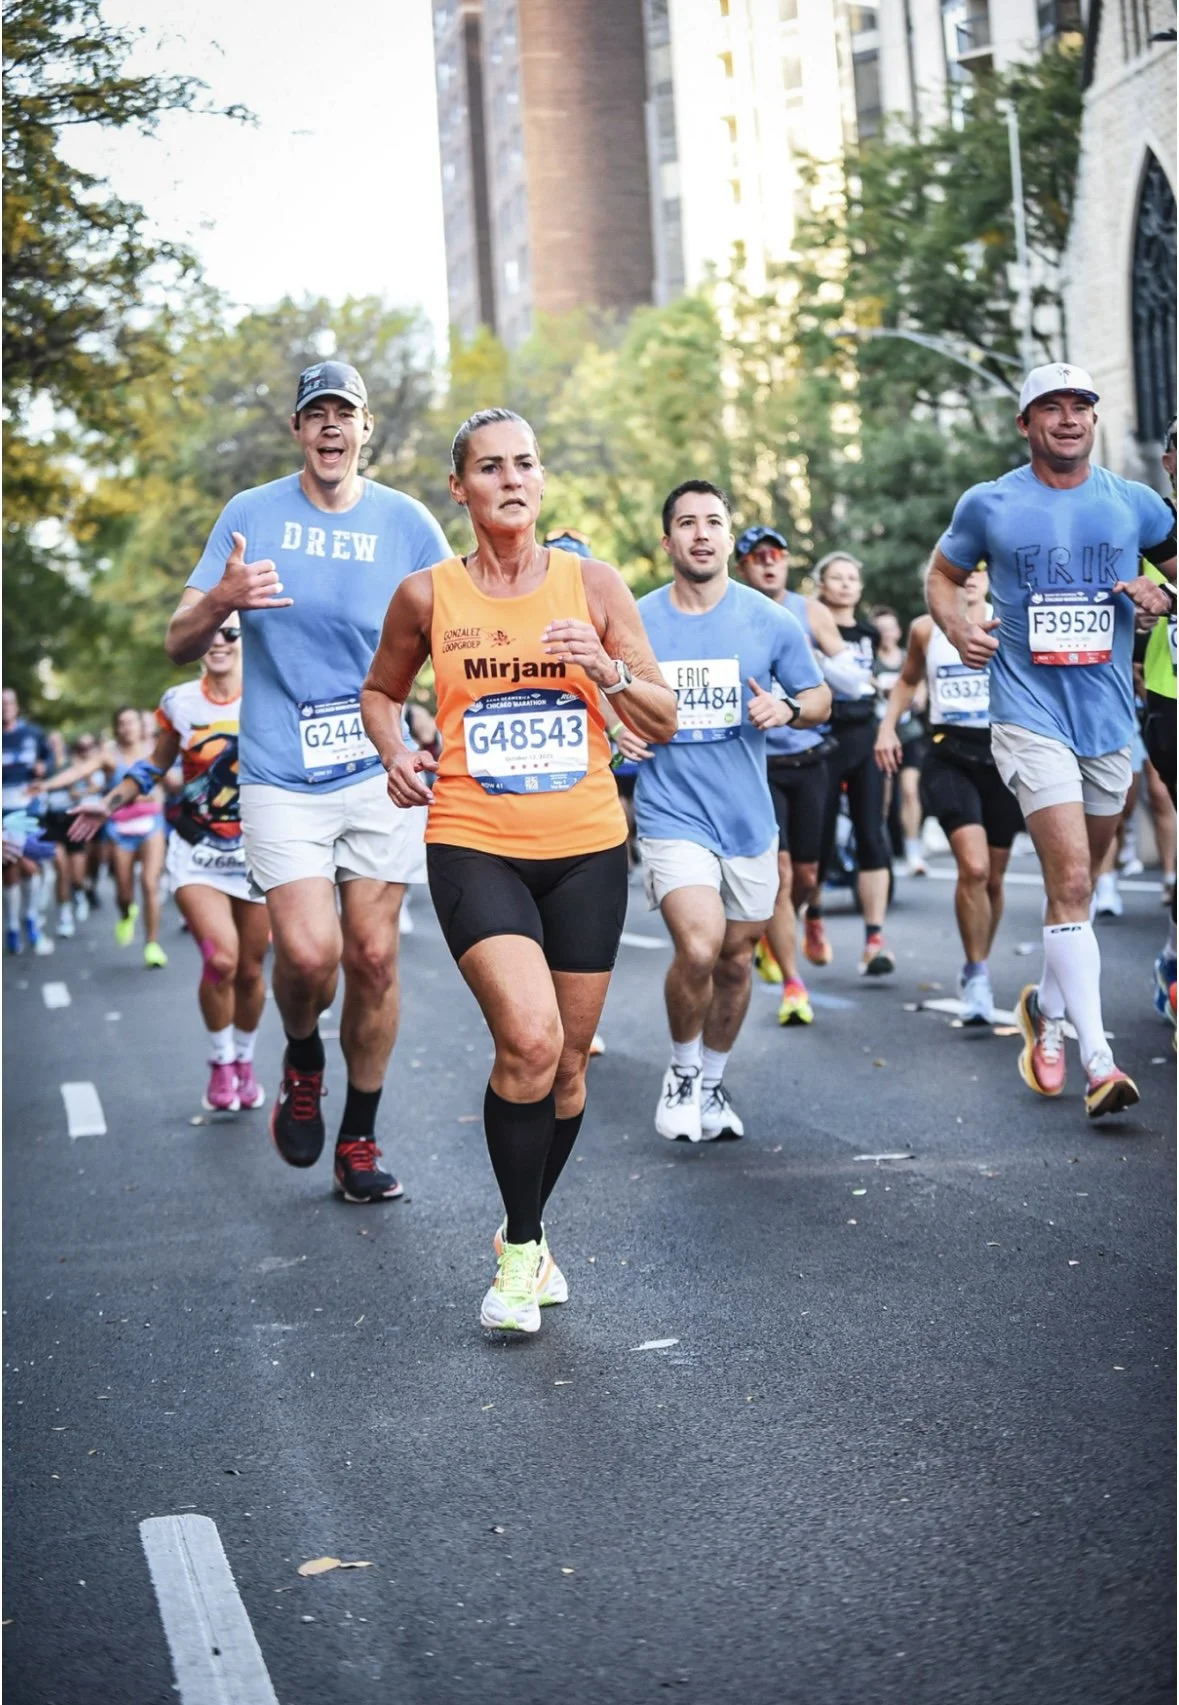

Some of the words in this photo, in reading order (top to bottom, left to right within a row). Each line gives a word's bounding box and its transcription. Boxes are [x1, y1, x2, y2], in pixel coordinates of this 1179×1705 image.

[281, 521, 378, 562] DREW
[1015, 542, 1123, 589] ERIK
[443, 628, 481, 640] GONZALEZ
[1033, 610, 1111, 634] F39520
[442, 640, 481, 653] LOOPGROEP
[463, 658, 566, 682] Mirjam
[677, 667, 710, 687] ERIC
[486, 701, 512, 710] CHICAGO
[513, 699, 547, 708] MARATHON
[305, 718, 368, 748] G244
[469, 715, 583, 754] G48543
